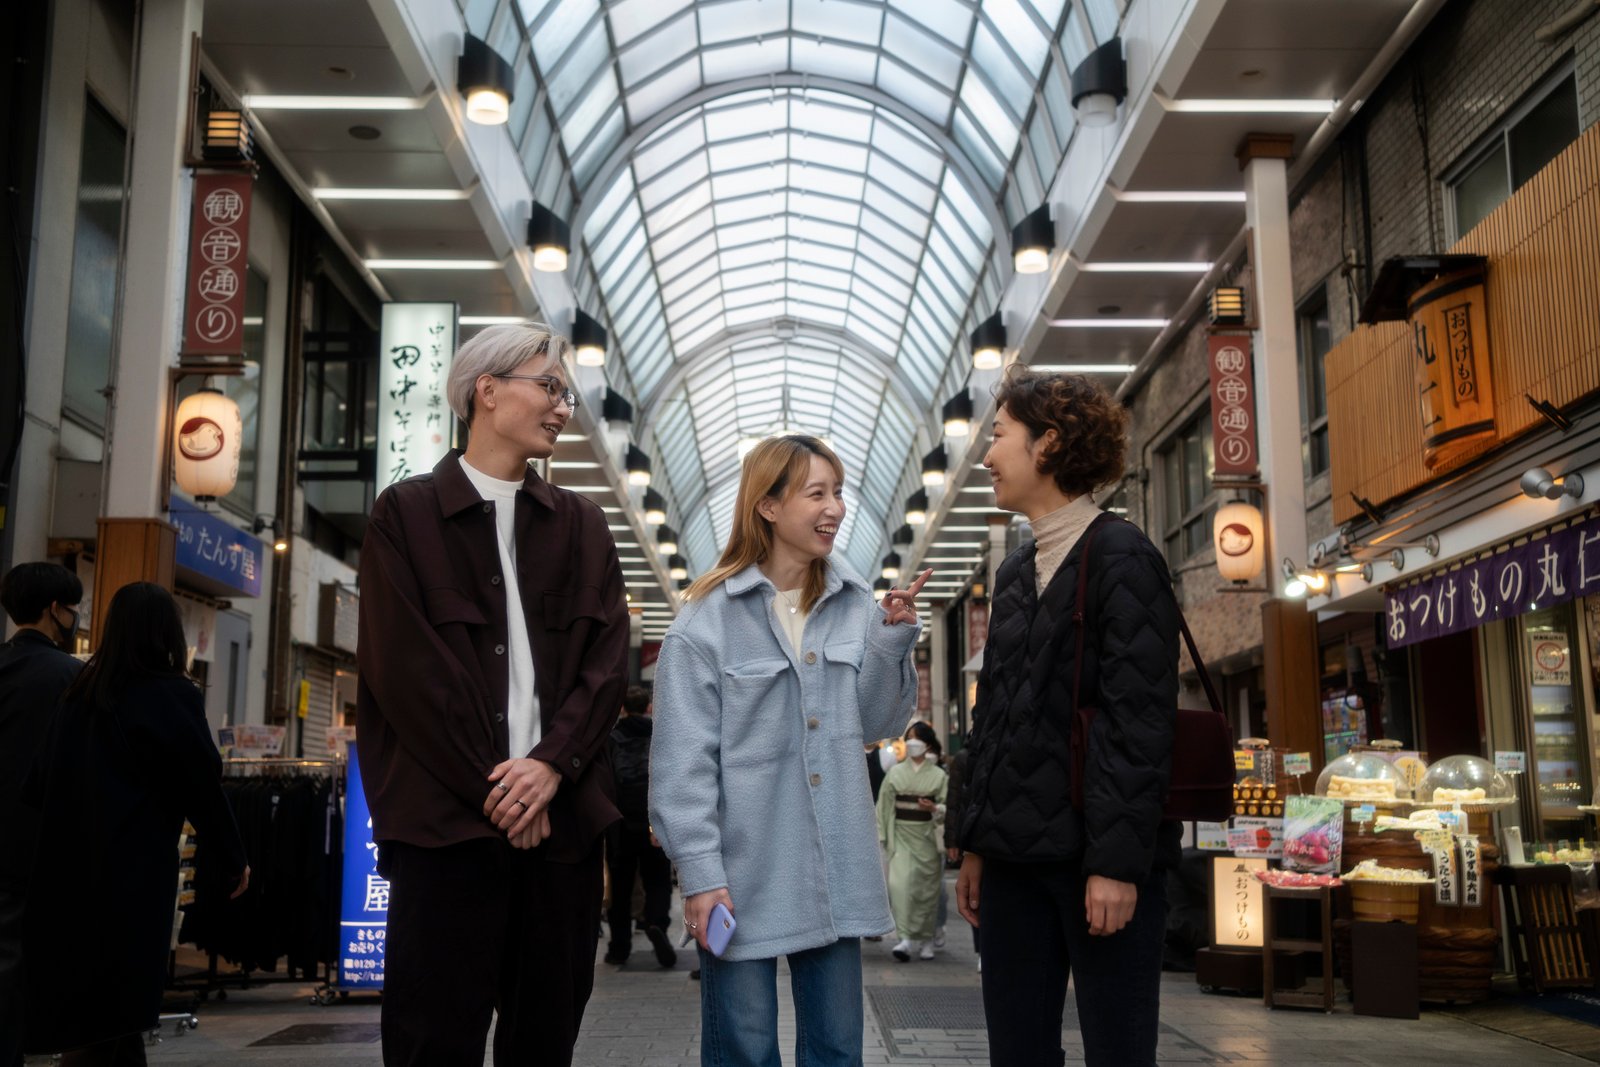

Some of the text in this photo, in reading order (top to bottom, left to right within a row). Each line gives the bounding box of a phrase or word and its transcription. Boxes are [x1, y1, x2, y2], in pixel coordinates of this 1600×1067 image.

[200, 190, 242, 340] 観音通り
[1414, 320, 1442, 434] 丸仁
[1451, 311, 1473, 396] おつけもの
[1216, 348, 1248, 462] 観音通り
[197, 525, 255, 580] たんす屋
[1389, 530, 1600, 641] おつけもの丸仁
[356, 928, 386, 941] きもの
[1236, 876, 1250, 941] おつけもの
